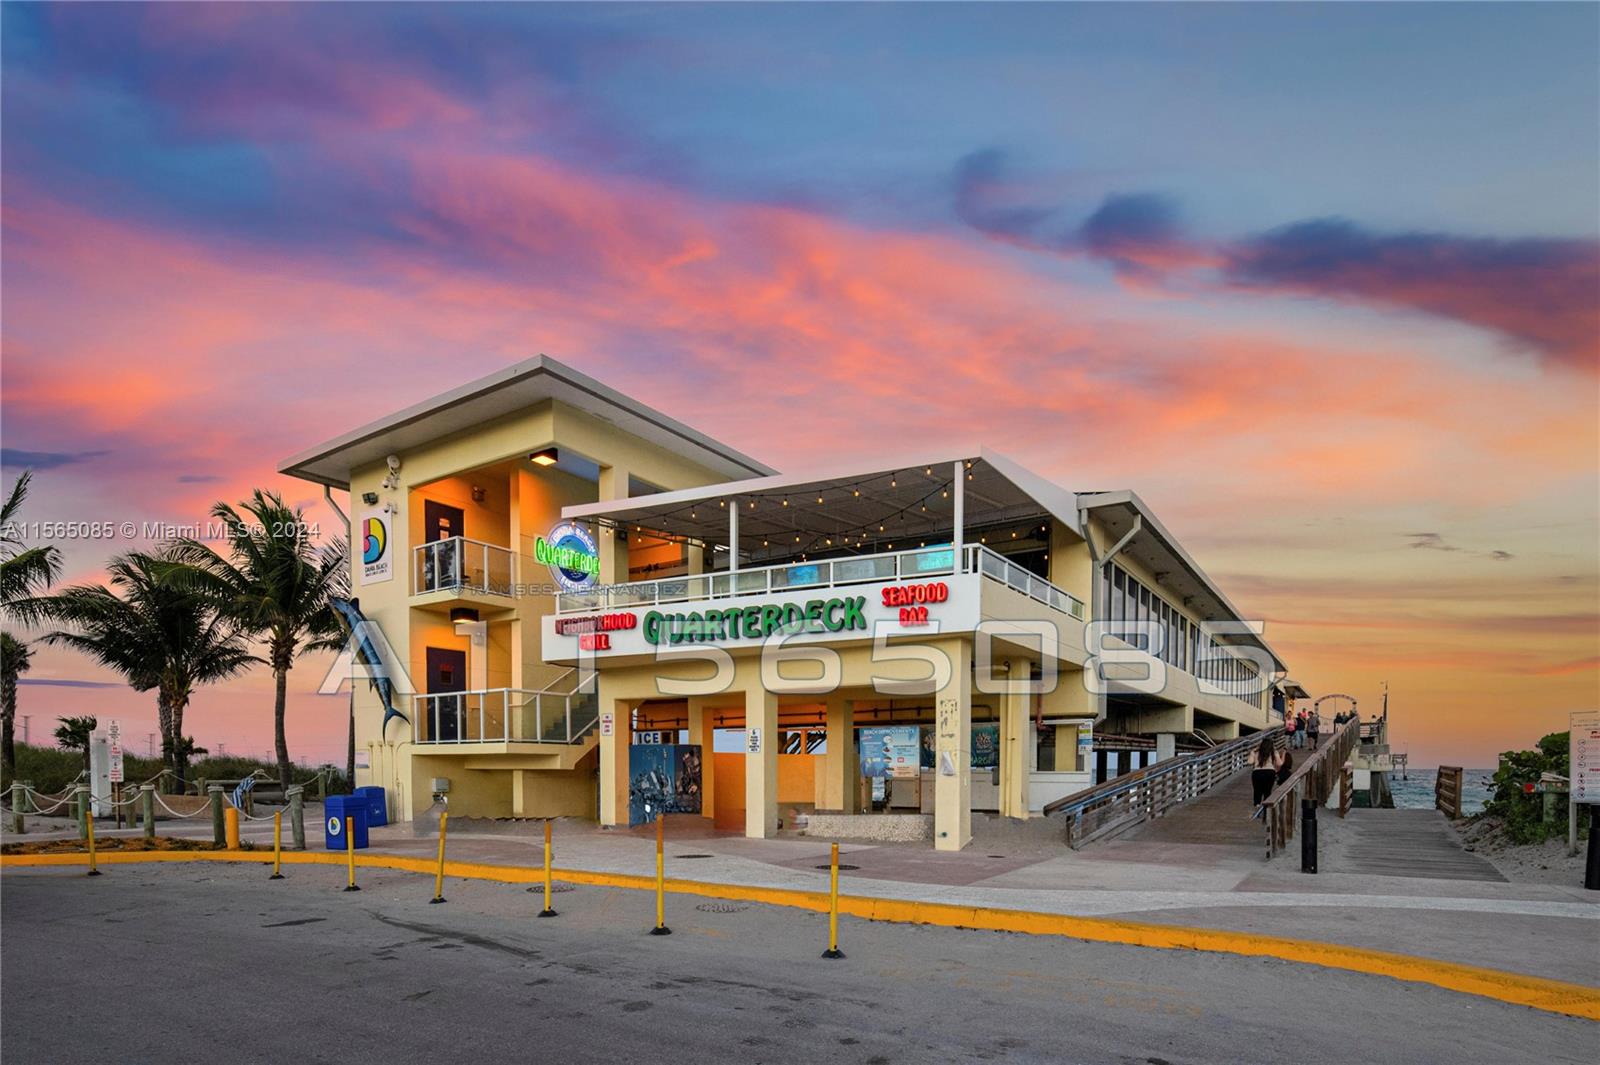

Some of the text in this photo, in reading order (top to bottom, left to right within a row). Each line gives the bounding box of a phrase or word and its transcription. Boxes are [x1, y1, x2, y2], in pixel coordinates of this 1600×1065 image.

[881, 582, 949, 607] SEAFOOD
[642, 596, 868, 645] QUARTERDECK
[899, 606, 929, 627] BAR
[638, 732, 659, 744] ICE
